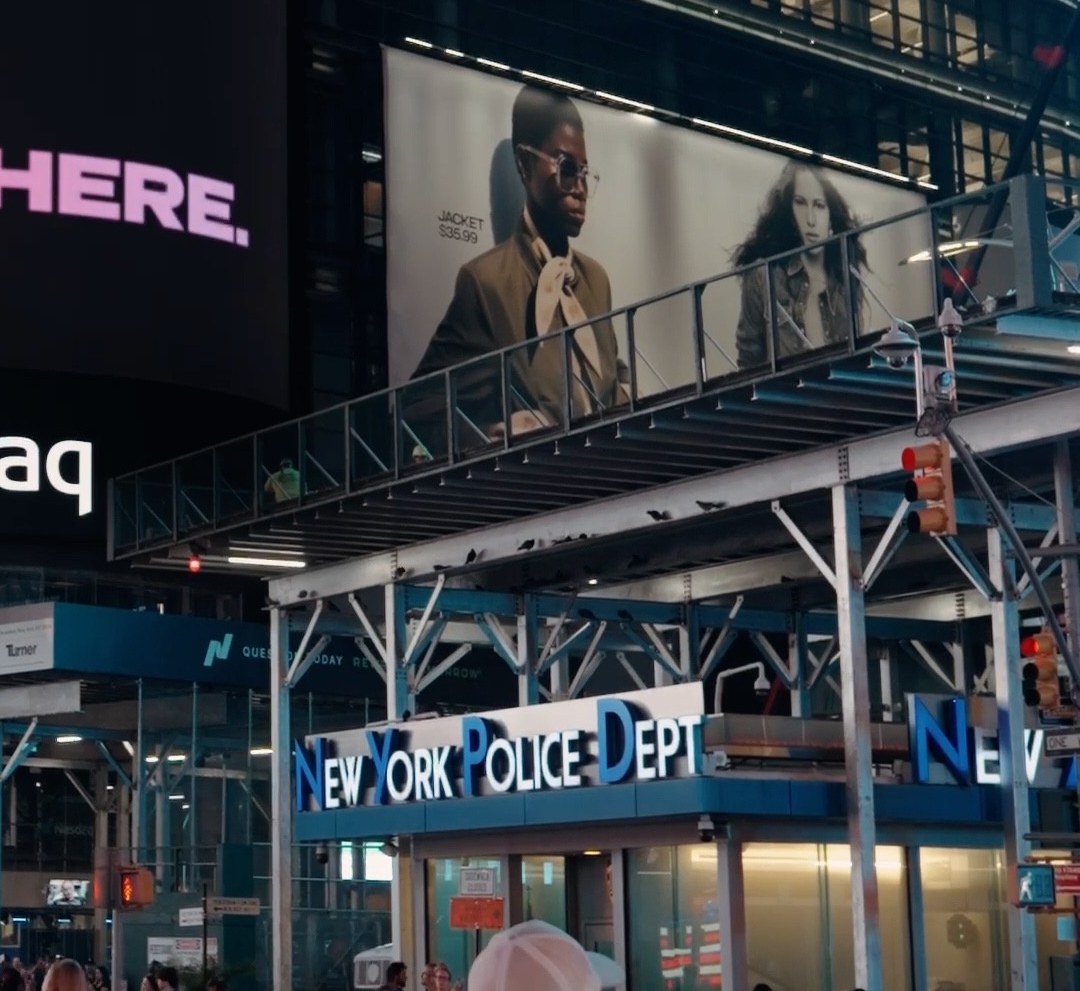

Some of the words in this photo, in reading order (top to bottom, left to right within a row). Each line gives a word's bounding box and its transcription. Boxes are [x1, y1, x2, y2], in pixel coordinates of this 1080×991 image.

[437, 210, 484, 230] JACKET
[439, 224, 478, 244] $35.99
[306, 651, 343, 666] ODAY
[1049, 736, 1067, 748] ONE
[295, 736, 361, 810] NEW
[366, 728, 454, 805] YORK
[462, 716, 580, 796] POLICE
[596, 698, 703, 784] DEPT
